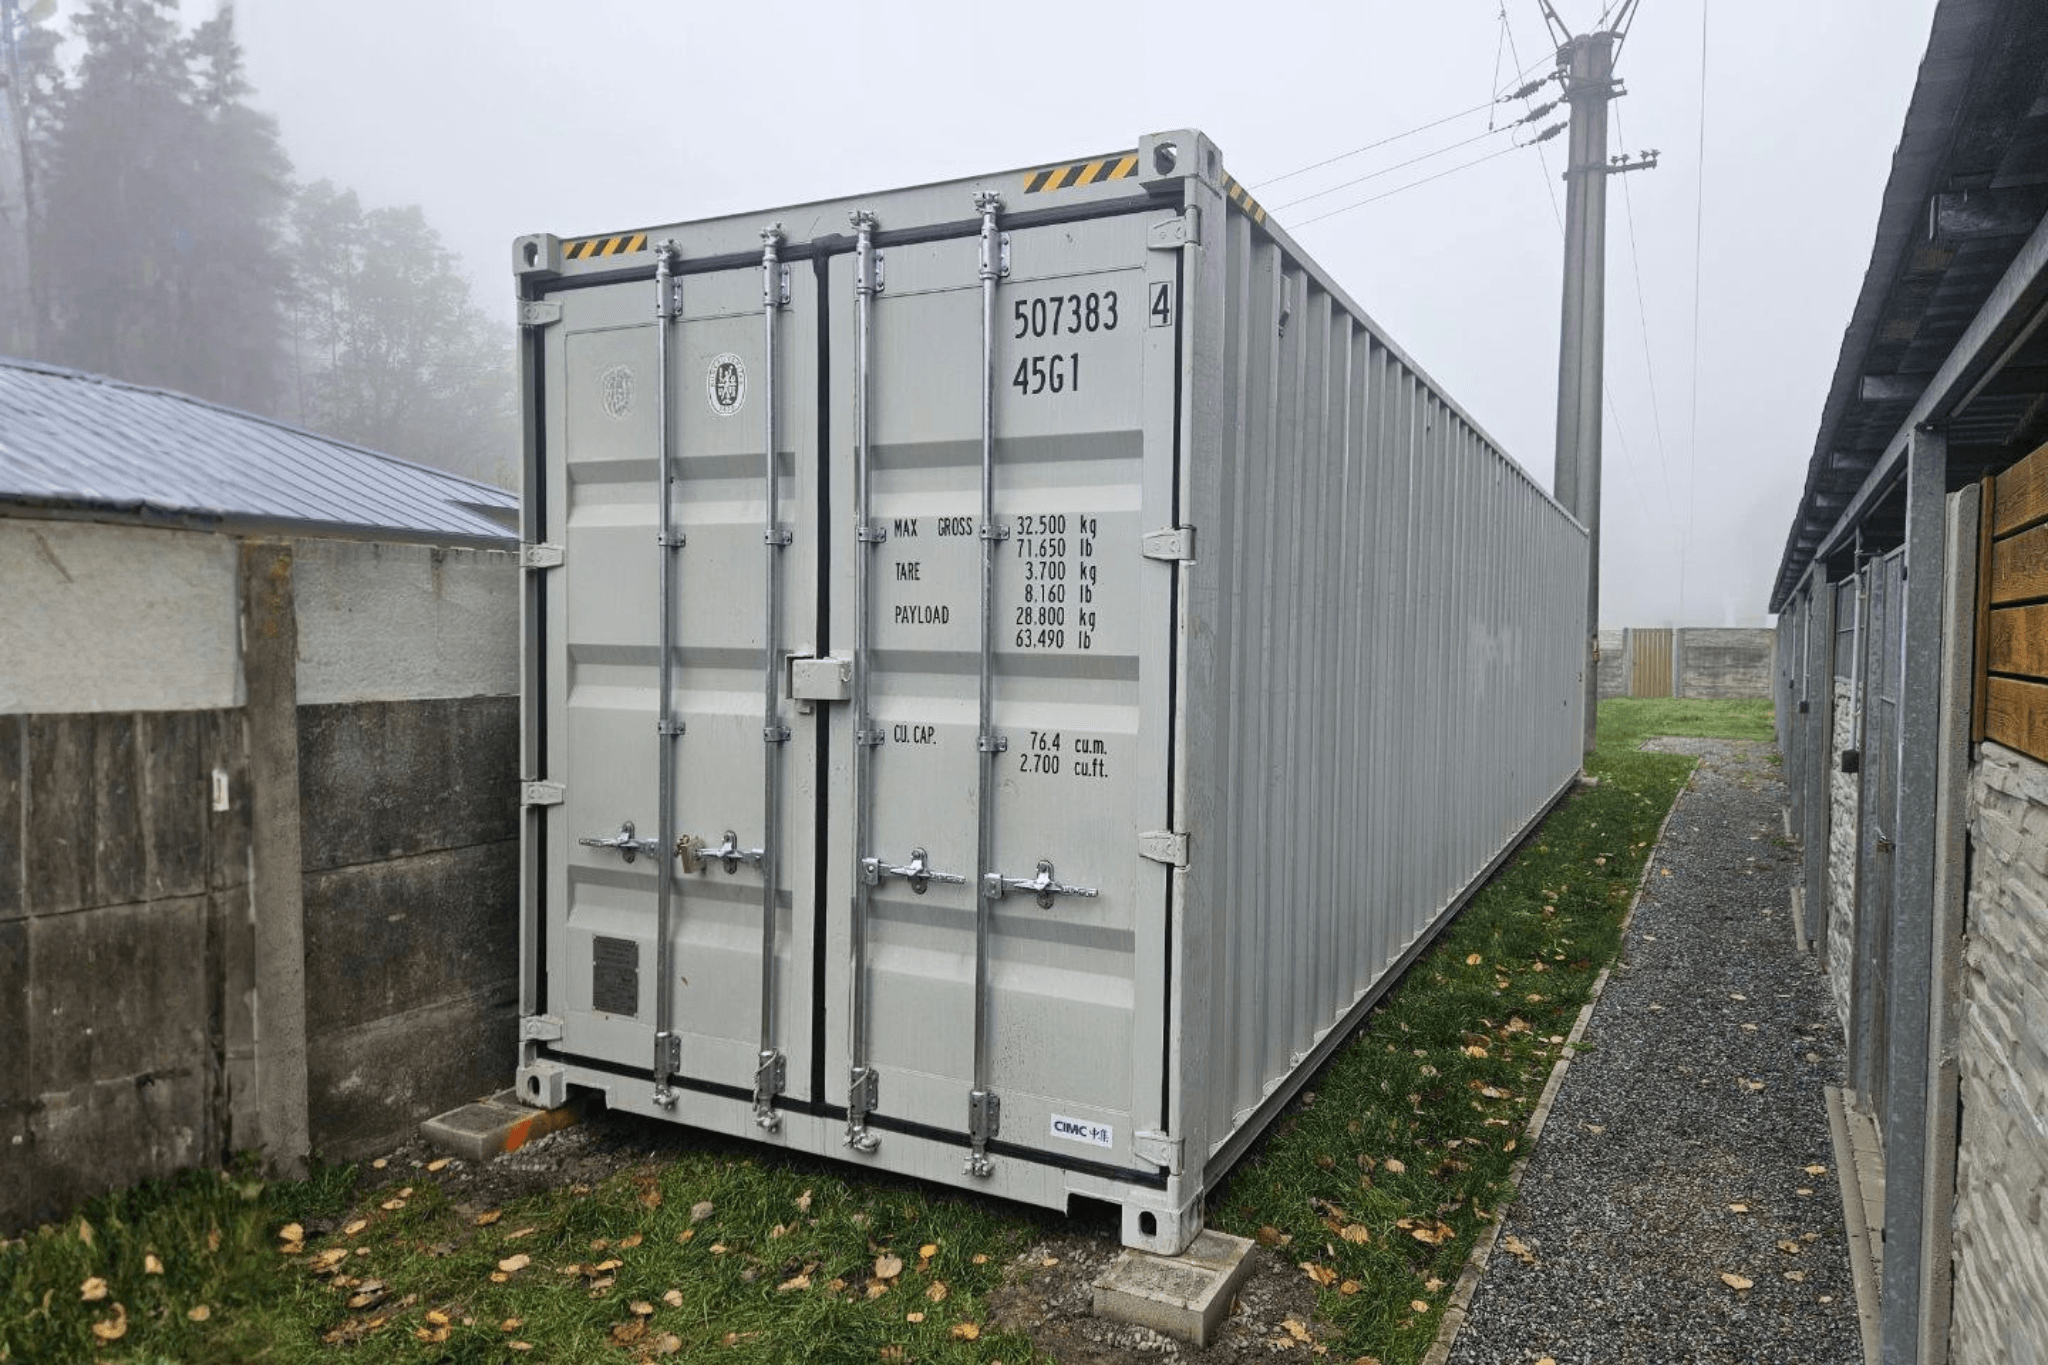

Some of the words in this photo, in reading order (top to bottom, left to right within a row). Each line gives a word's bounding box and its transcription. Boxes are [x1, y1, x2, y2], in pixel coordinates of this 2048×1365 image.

[1015, 290, 1118, 339] 507383
[1152, 284, 1169, 324] 4
[1013, 352, 1079, 395] 45G1
[894, 518, 918, 537] MAX
[938, 517, 973, 536] GROSS
[1017, 515, 1066, 536] 32.500
[1080, 515, 1097, 539] kg
[1017, 538, 1066, 558] 71.650
[1080, 538, 1093, 557] lb
[895, 562, 921, 581] TARE
[1025, 561, 1066, 580] 3.700
[1080, 562, 1097, 585] kg
[1025, 584, 1065, 603] 8.160
[1080, 584, 1092, 603] lb
[895, 605, 950, 624] PAYLOAD
[1016, 606, 1065, 626] 28.800
[1078, 607, 1096, 632] kg
[1016, 629, 1065, 648] 63.490
[1078, 630, 1092, 649] lb
[894, 724, 910, 743] CU.
[913, 726, 937, 745] CAP.
[1030, 731, 1061, 751] 76.4
[1074, 738, 1108, 755] cu.m.
[1020, 753, 1060, 774] 2.700
[1074, 757, 1109, 778] cu.ft.
[1054, 1120, 1087, 1137] CIMC
